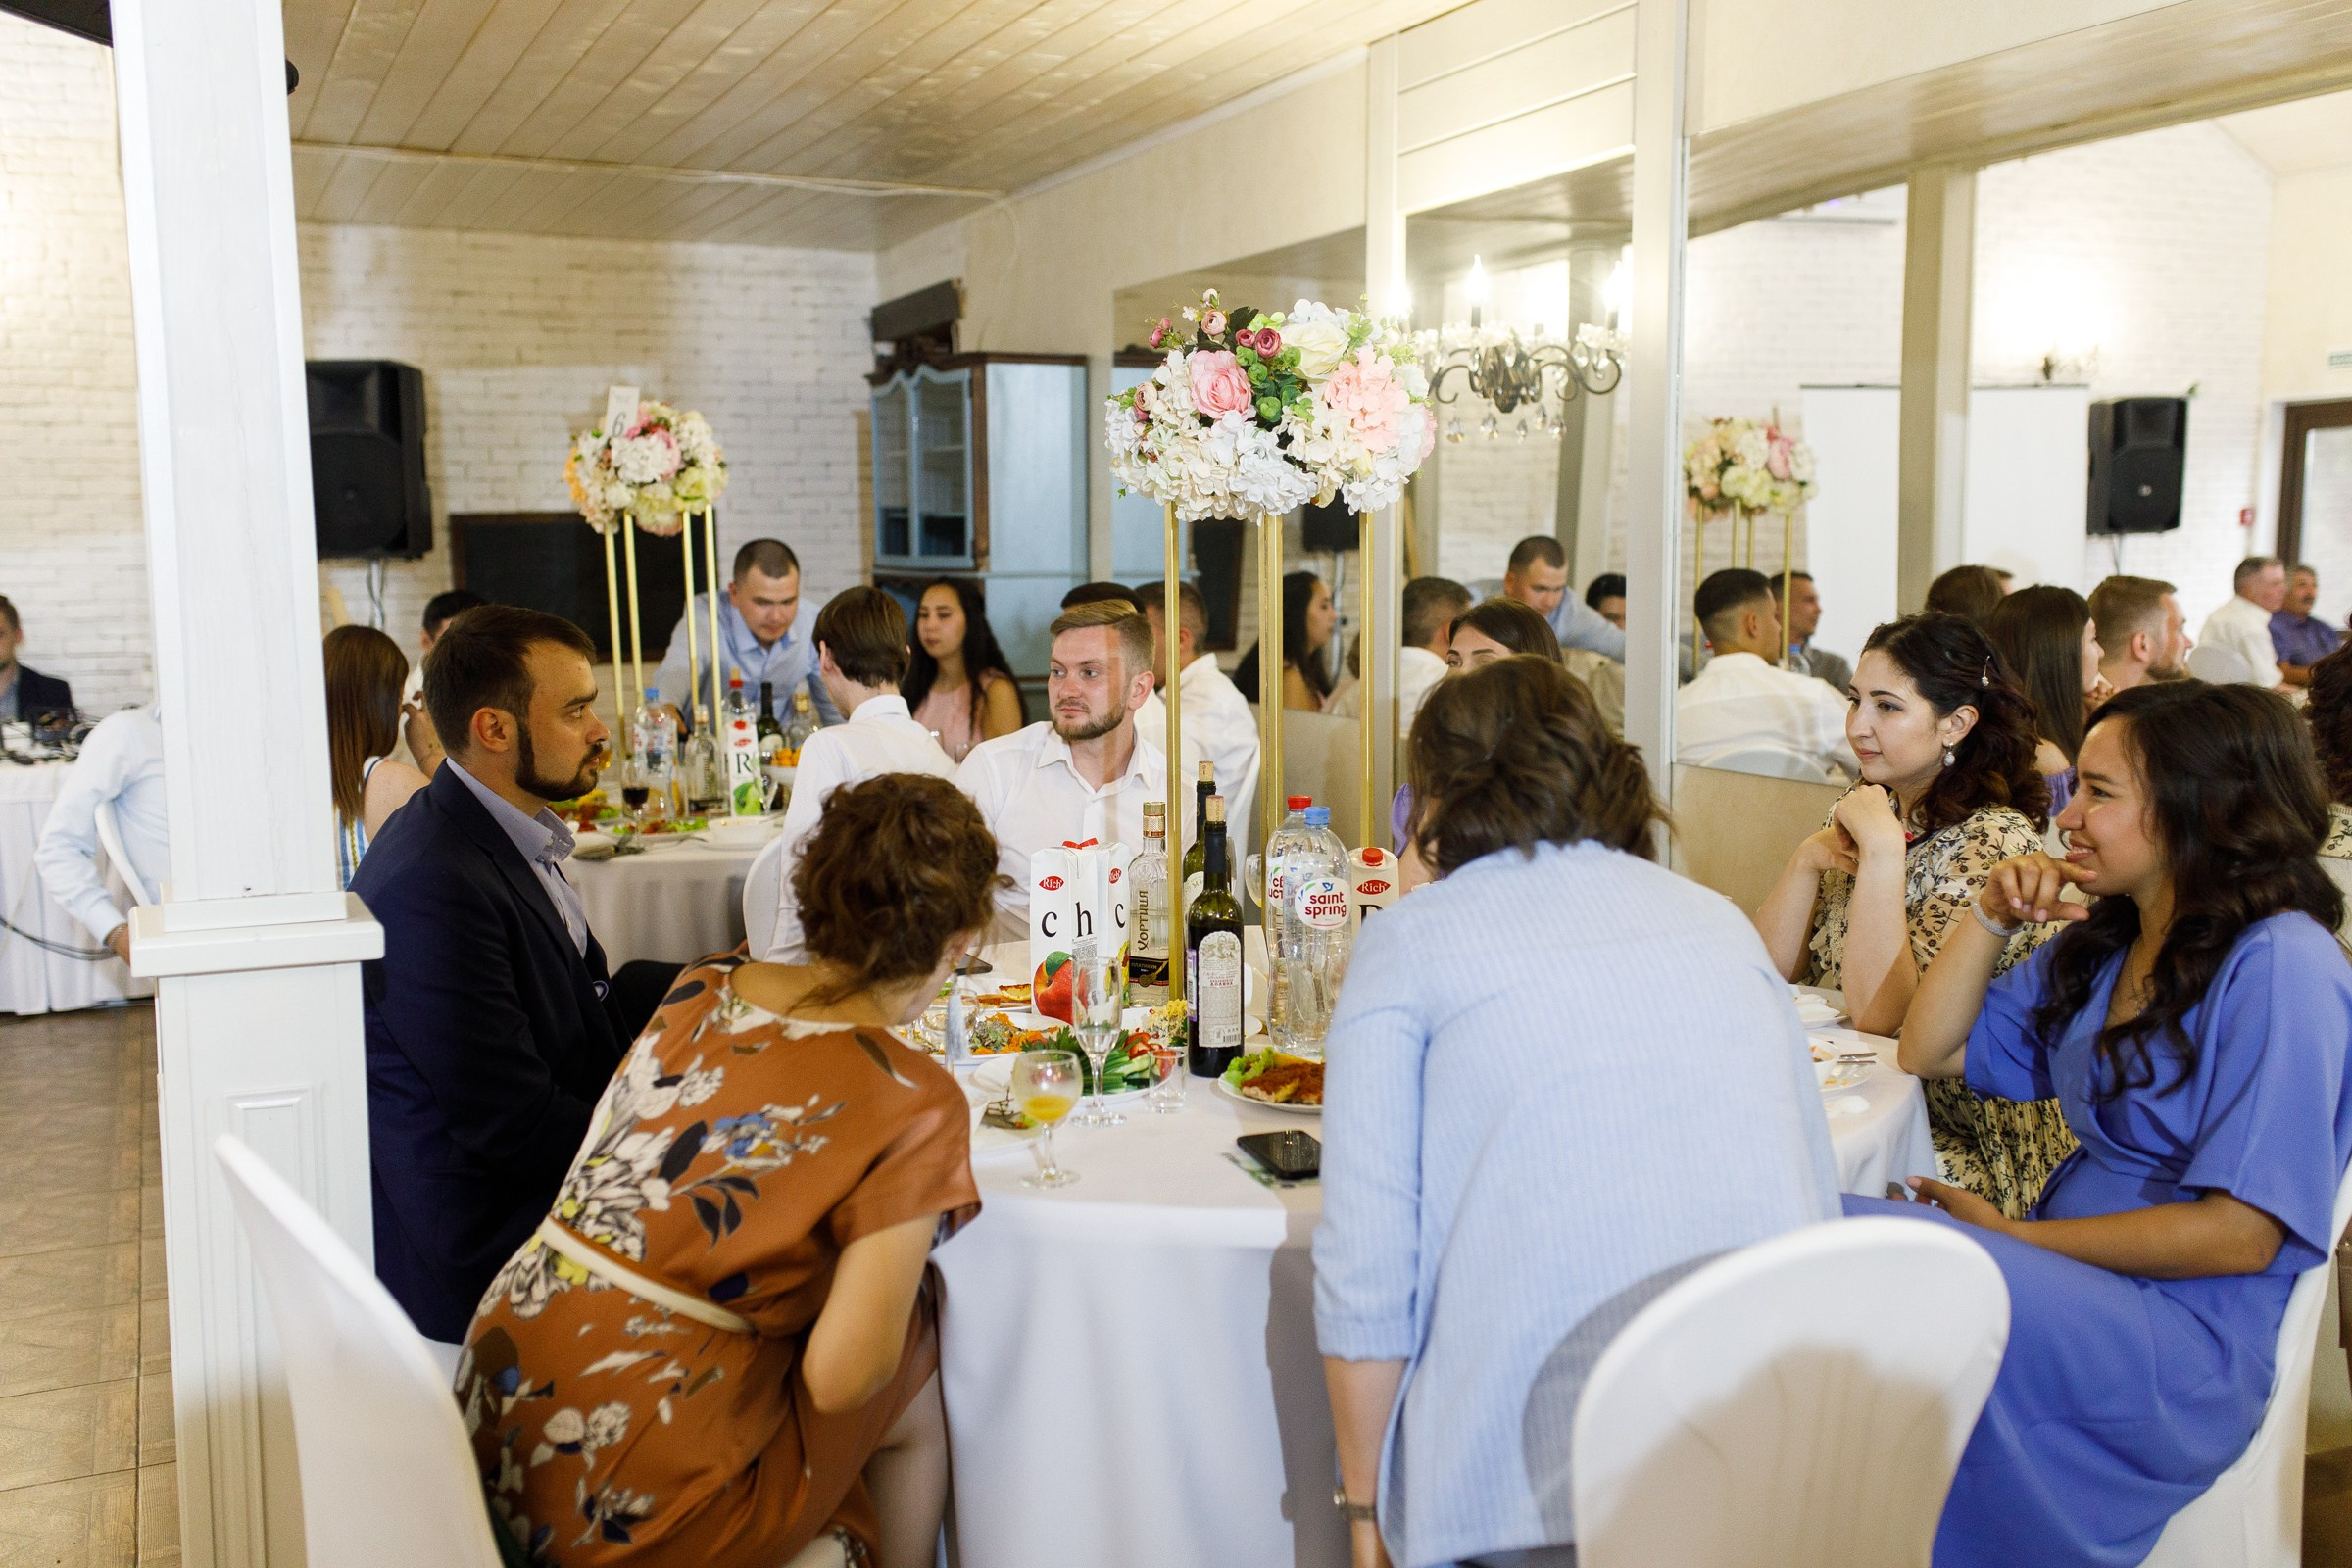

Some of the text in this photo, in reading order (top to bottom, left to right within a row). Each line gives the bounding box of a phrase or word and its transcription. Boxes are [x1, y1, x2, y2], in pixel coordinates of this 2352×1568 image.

[612, 411, 626, 438] 6
[1043, 878, 1061, 889] Rich
[1361, 882, 1387, 893] Rich
[1309, 891, 1344, 904] saint
[1305, 904, 1347, 919] spring
[1075, 901, 1094, 938] h
